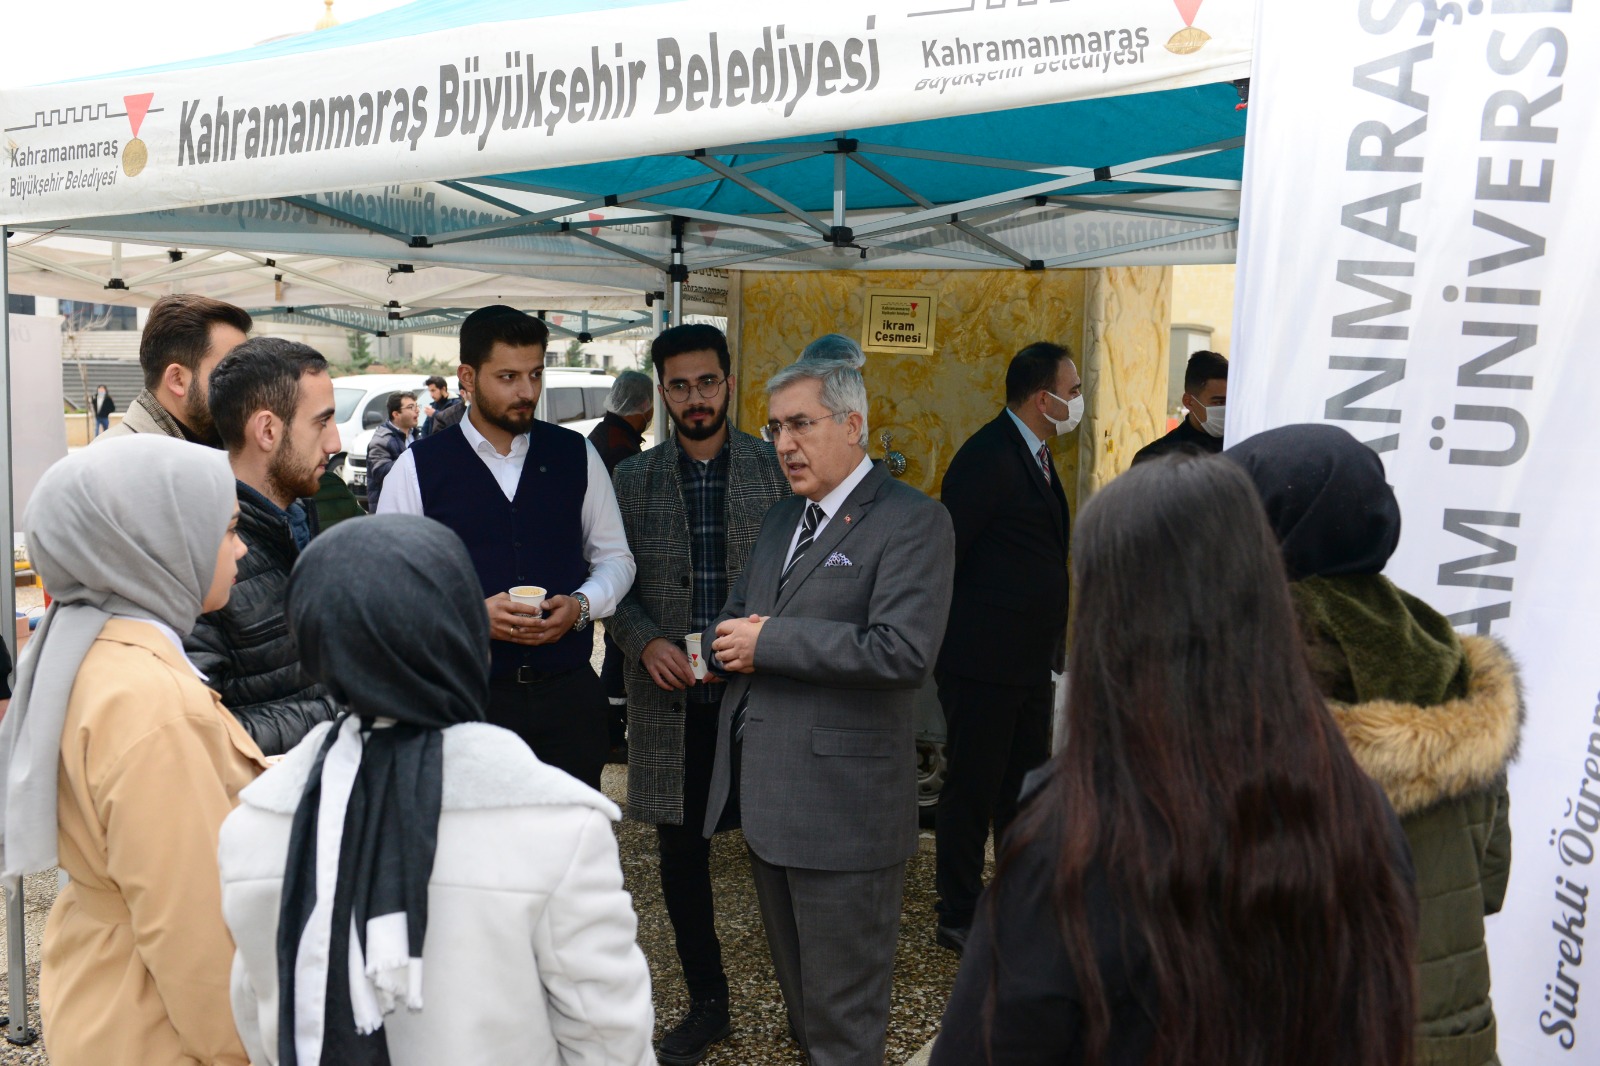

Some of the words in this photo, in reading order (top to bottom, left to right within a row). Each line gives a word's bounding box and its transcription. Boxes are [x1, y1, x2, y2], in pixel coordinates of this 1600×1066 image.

[178, 85, 428, 166] Kahramanmaraş
[434, 42, 647, 151] Büyükşehir
[653, 15, 880, 118] Belediyesi
[10, 139, 119, 168] Kahramanmaraş
[10, 172, 64, 201] Büyükşehir
[65, 165, 118, 192] Belediyesi
[875, 331, 921, 343] Çeşmesi
[882, 320, 914, 331] ikram
[1539, 875, 1590, 1050] Sürekli
